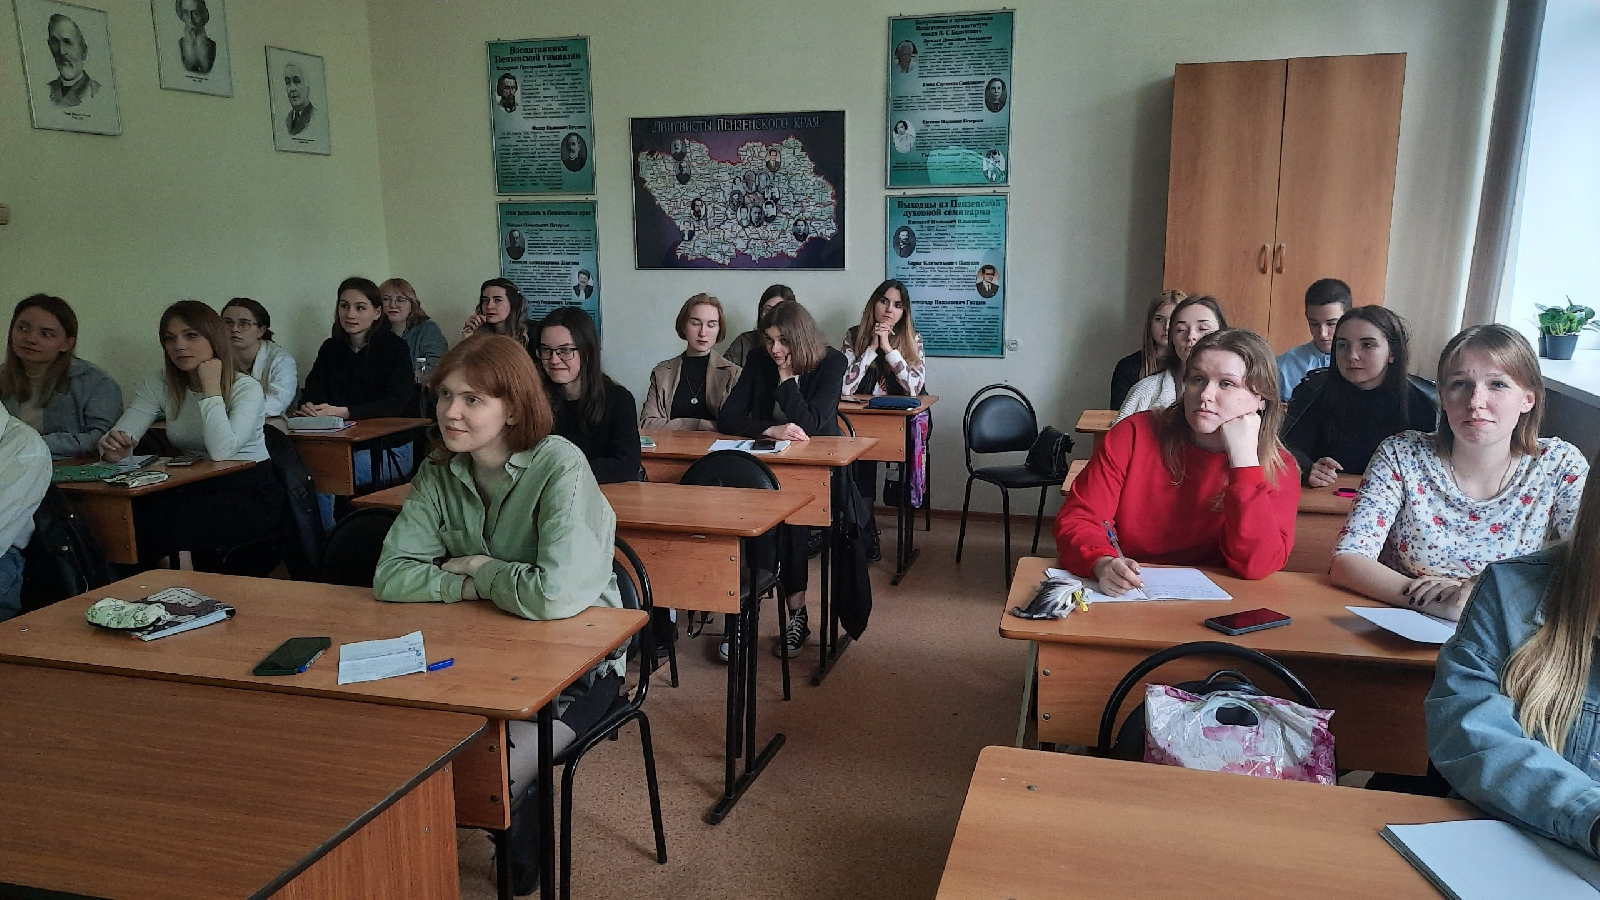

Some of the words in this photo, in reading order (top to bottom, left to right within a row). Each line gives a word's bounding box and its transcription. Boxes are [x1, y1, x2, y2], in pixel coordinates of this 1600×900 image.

[510, 45, 568, 54] Воспитанники
[495, 54, 540, 63] Пензенской
[543, 53, 581, 61] гимназии
[897, 200, 937, 209] Выходцы
[950, 199, 1001, 208] Пензенской
[902, 208, 941, 218] духовной
[943, 209, 991, 218] семинарии
